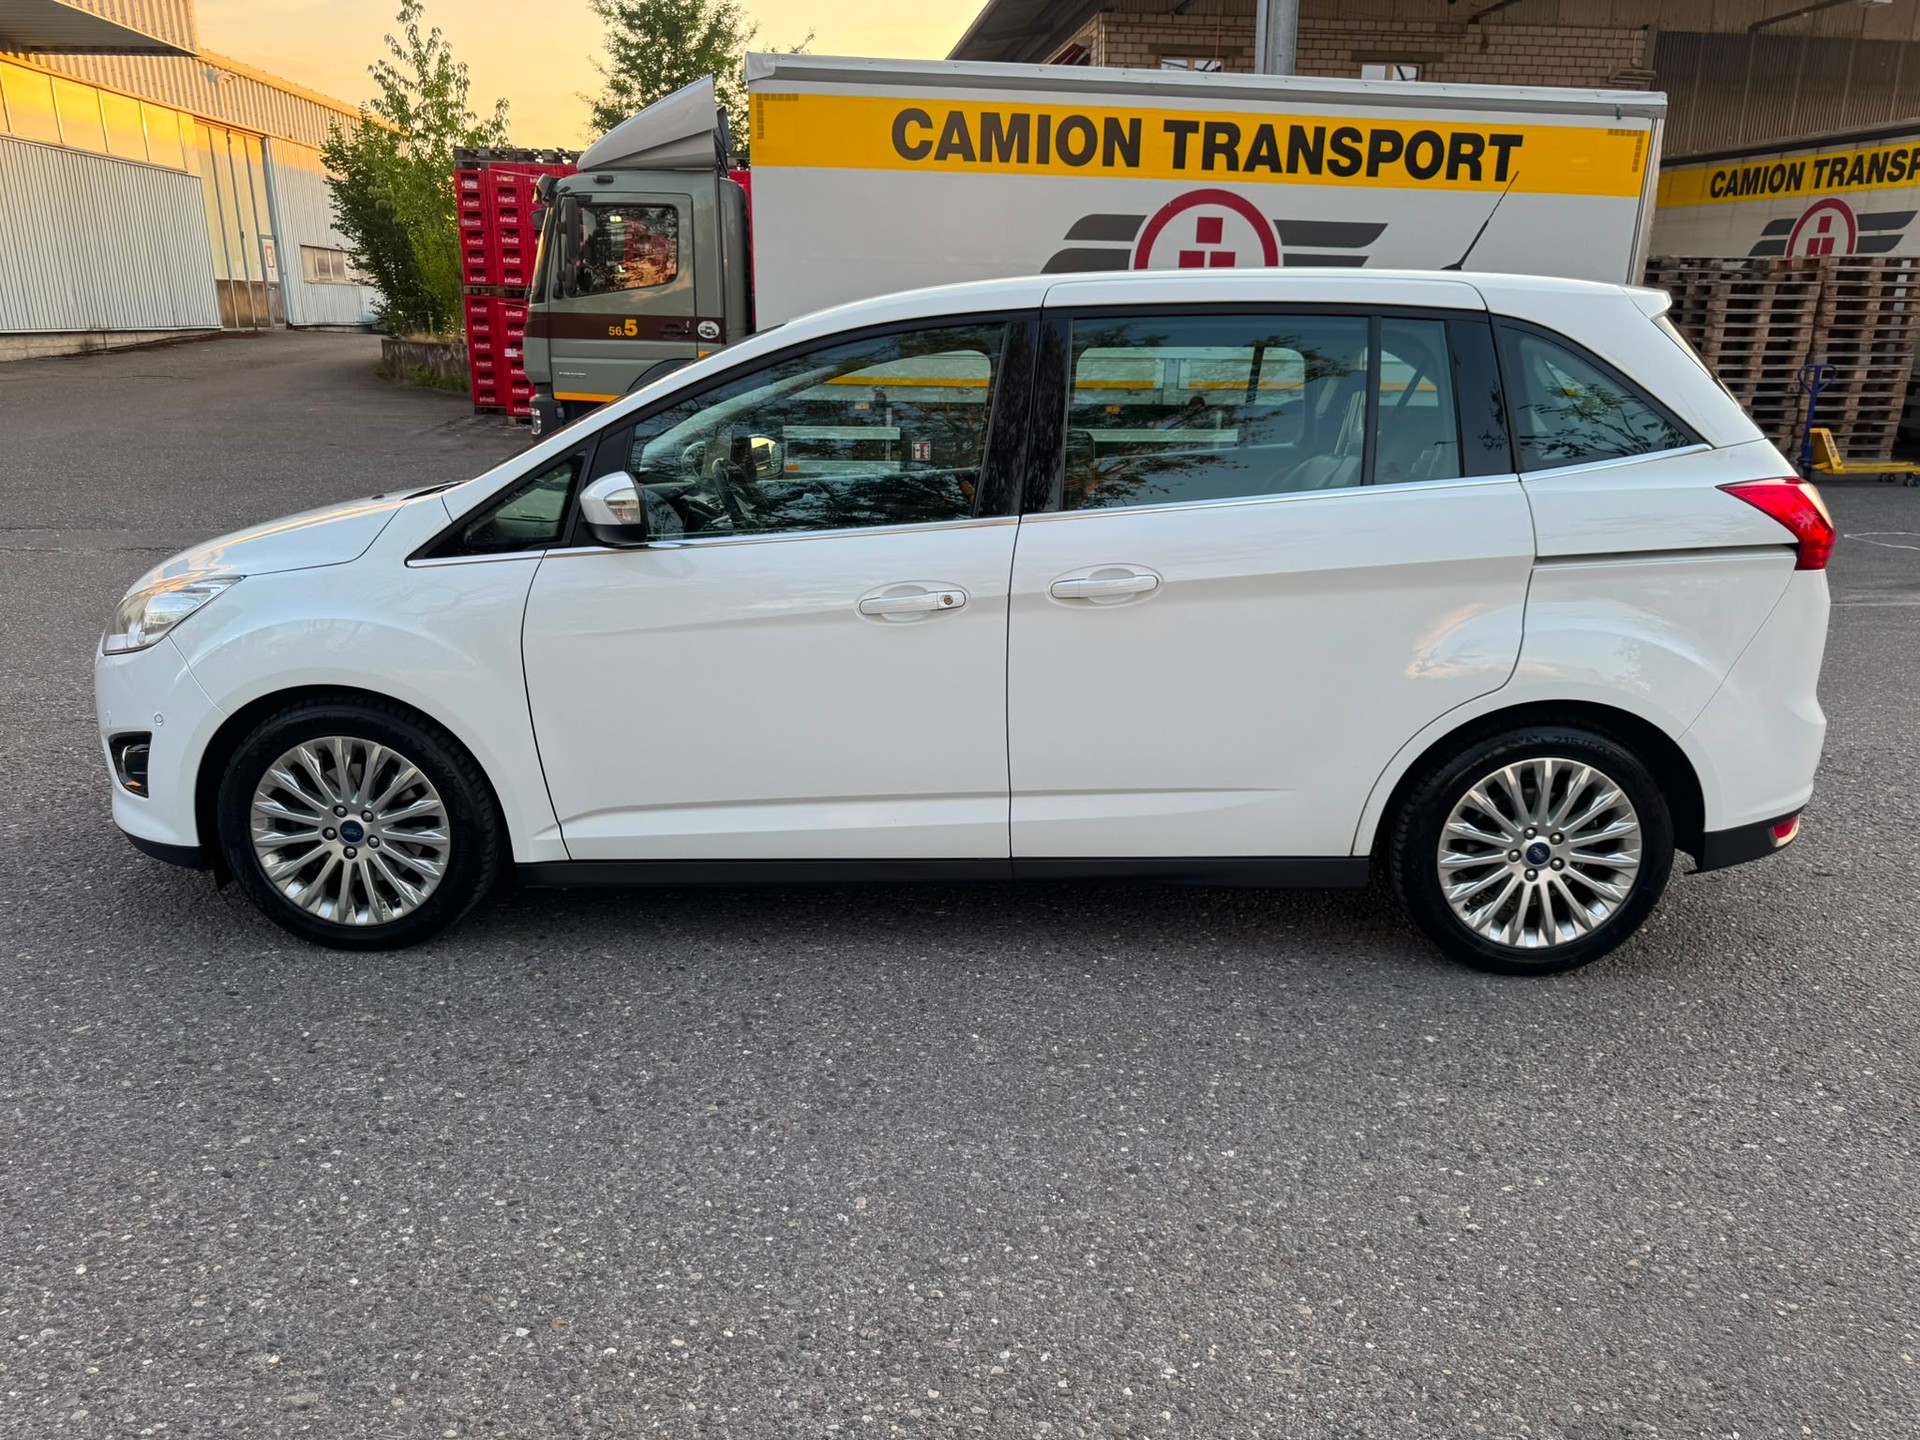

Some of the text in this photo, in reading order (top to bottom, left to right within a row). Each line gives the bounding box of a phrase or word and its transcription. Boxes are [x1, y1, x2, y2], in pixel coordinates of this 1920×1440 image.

[891, 108, 1524, 183] CAMION TRANSPORT
[1710, 147, 1920, 199] CAMION TRANSP
[608, 318, 638, 337] 56.5
